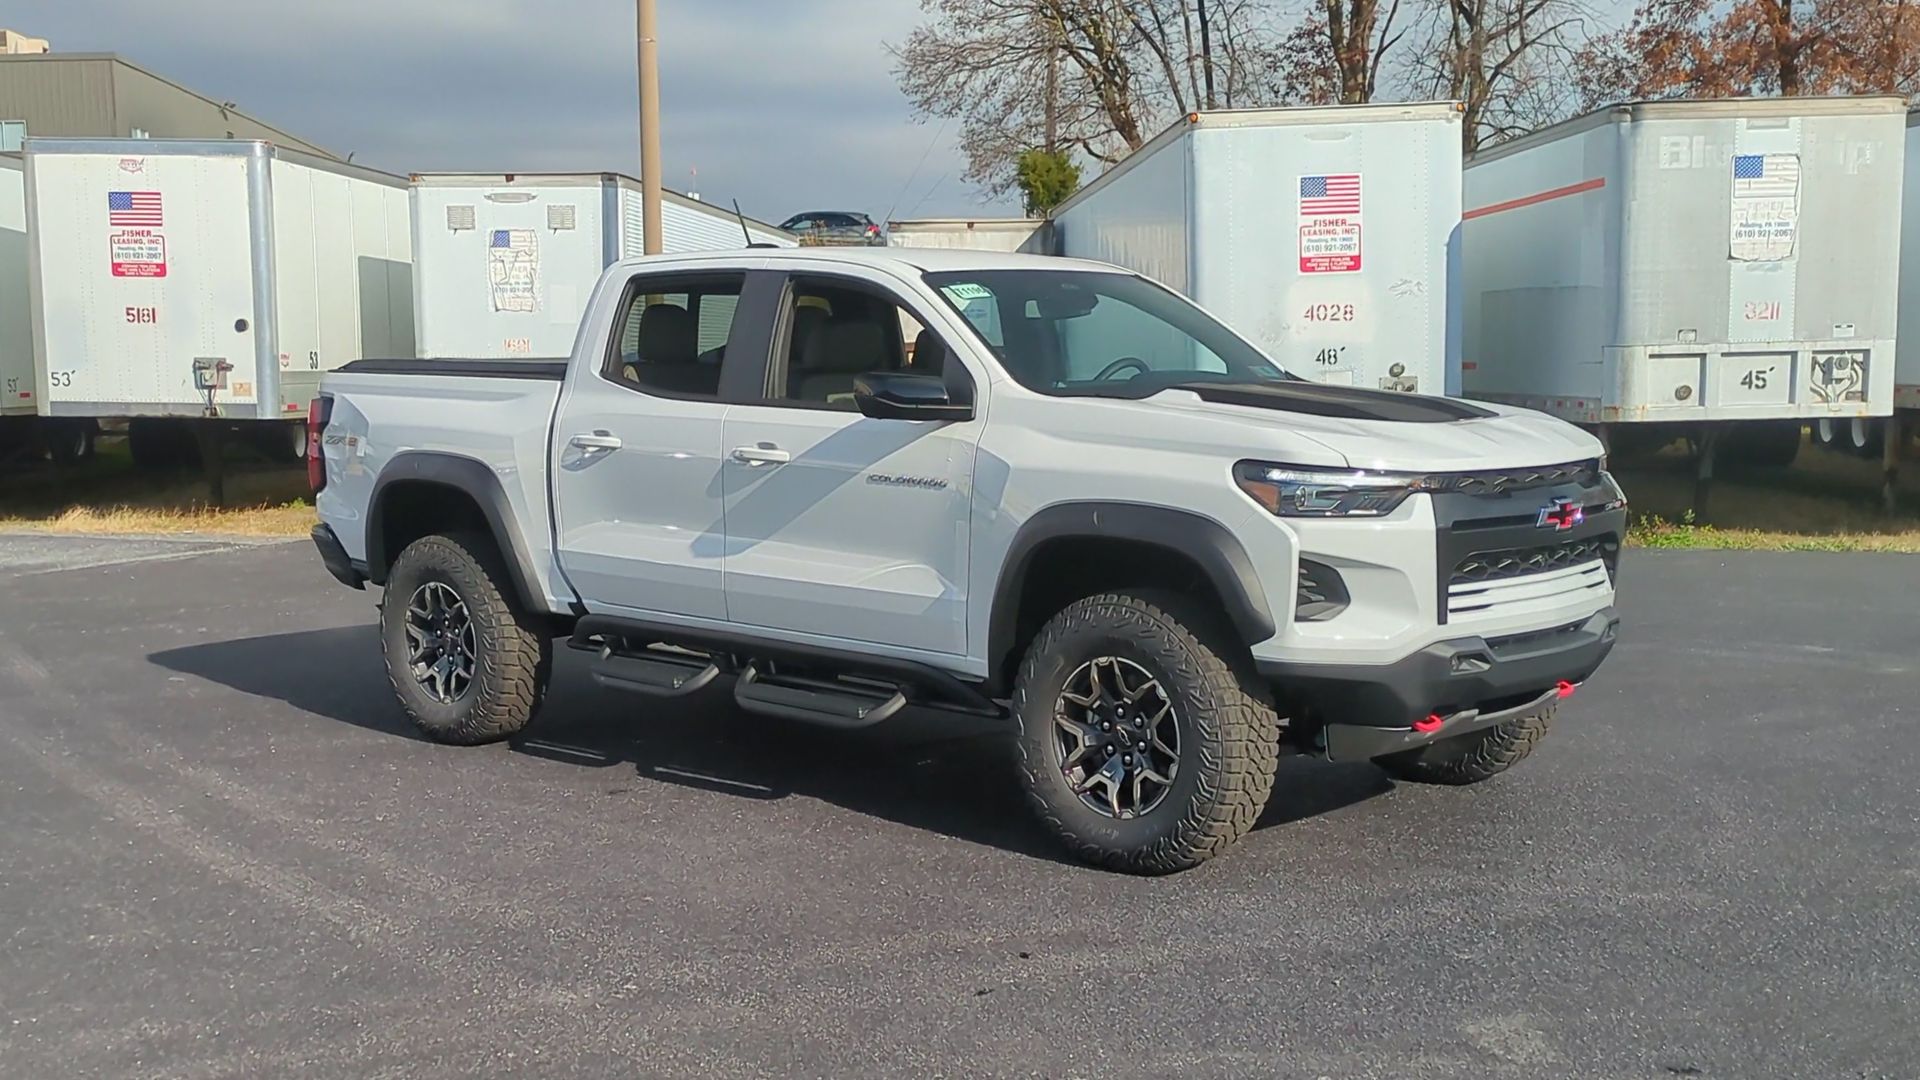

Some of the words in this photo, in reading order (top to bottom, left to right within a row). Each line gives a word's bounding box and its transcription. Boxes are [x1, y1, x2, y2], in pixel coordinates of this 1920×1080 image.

[1313, 219, 1347, 228] FISHER
[1303, 228, 1340, 236] LEASING,
[1735, 229, 1755, 240] (610)
[1757, 229, 1793, 238] 921-2067
[1304, 244, 1322, 253] (610)
[1324, 243, 1357, 252] 921-2067
[126, 307, 156, 323] 5181
[1304, 304, 1354, 321] 4028
[1744, 301, 1780, 320] 3211
[310, 352, 319, 369] 53
